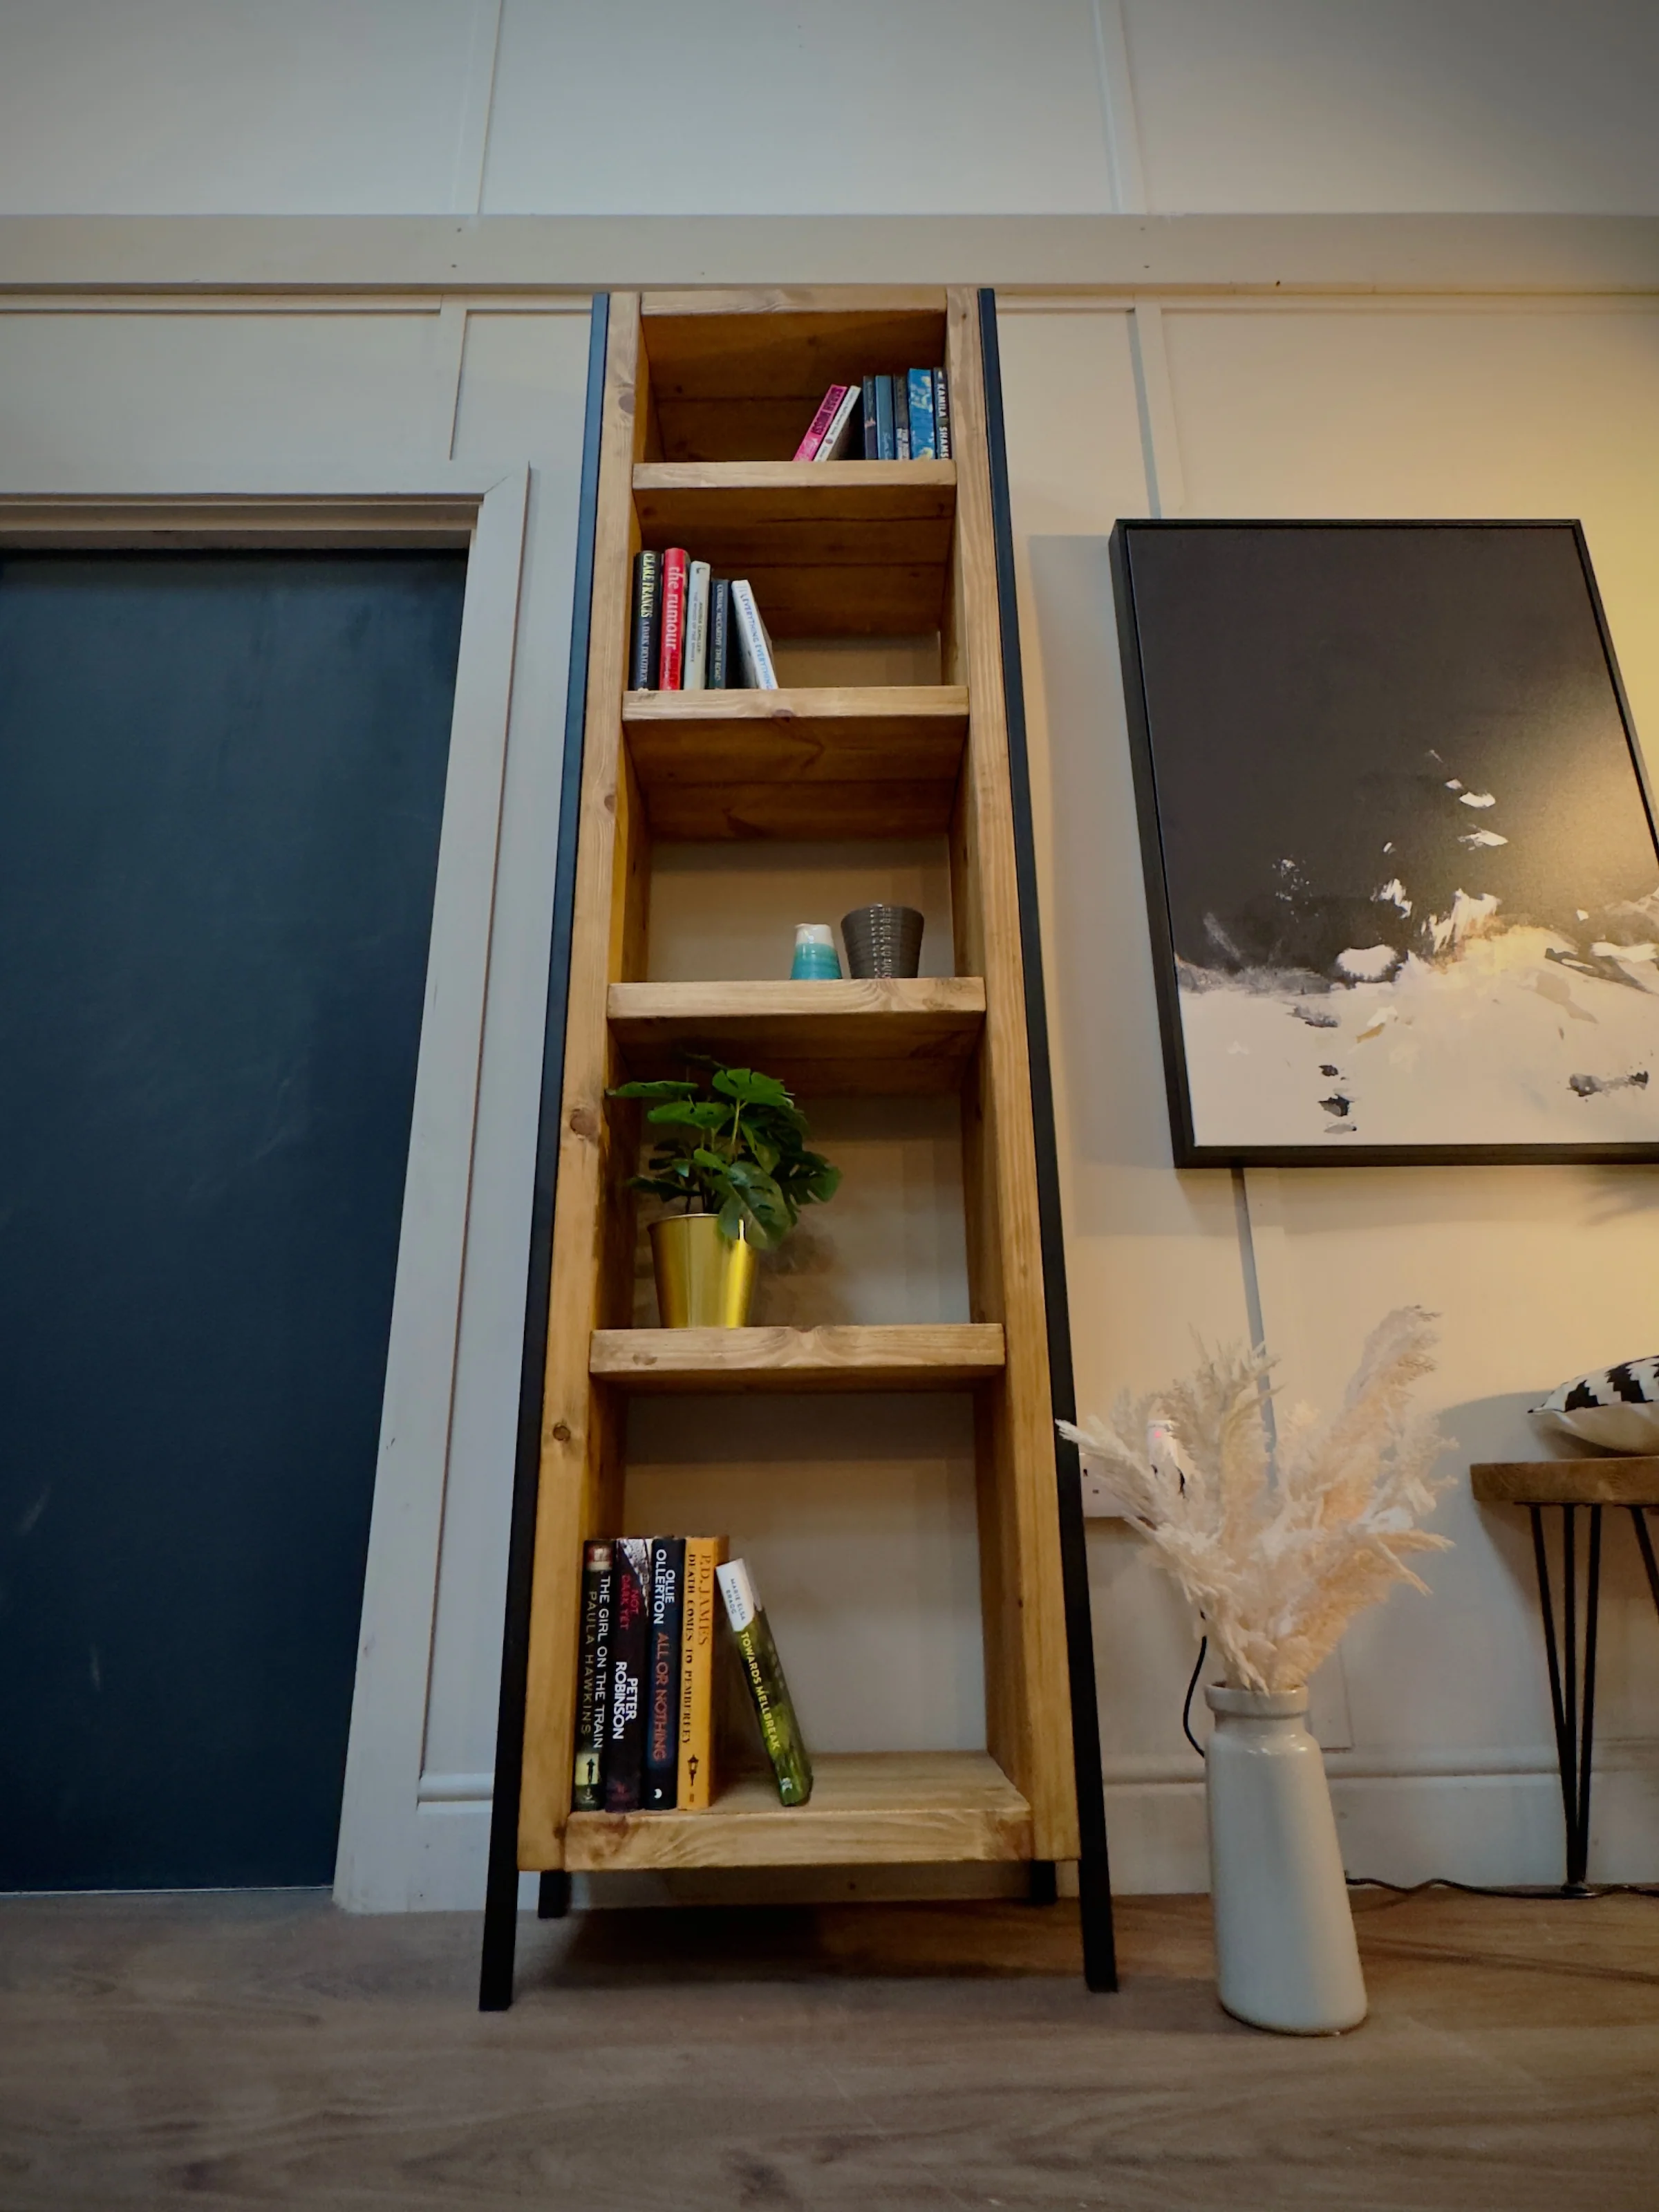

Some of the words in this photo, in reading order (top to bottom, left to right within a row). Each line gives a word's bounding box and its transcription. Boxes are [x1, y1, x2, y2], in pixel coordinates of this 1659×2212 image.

[937, 384, 946, 418] KAMILA
[642, 553, 655, 581] CLARE
[668, 567, 684, 589] the
[641, 582, 654, 618] FRANCIS
[666, 594, 678, 650] rumour
[742, 599, 759, 643] EVERYTHING
[600, 1576, 611, 1604] THE
[620, 1574, 630, 1606] DARK
[653, 1549, 667, 1624] OLLERTON
[665, 1570, 676, 1604] OLLIE
[688, 1554, 696, 1593] DEATH
[630, 1590, 639, 1615] NOT
[698, 1586, 710, 1646] JAMES
[726, 1589, 737, 1615] BRAGG
[731, 1578, 741, 1601] MARIE
[737, 1603, 746, 1621] ELSA
[585, 1591, 597, 1644] PAULA
[597, 1609, 609, 1642] GIRL
[620, 1609, 630, 1631] YET
[686, 1600, 695, 1642] COMES
[597, 1646, 608, 1668] ON
[657, 1632, 670, 1660] ALL
[685, 1649, 693, 1664] TO
[595, 1671, 606, 1702] THE
[655, 1662, 668, 1686] OR
[741, 1631, 762, 1685] TOWARDS
[755, 1685, 780, 1751] MELLBREAK
[581, 1654, 594, 1735] HAWKINS
[612, 1661, 628, 1740] ROBINSON
[625, 1678, 638, 1721] PETER
[593, 1704, 605, 1748] TRAIN
[653, 1689, 668, 1761] NOTHING
